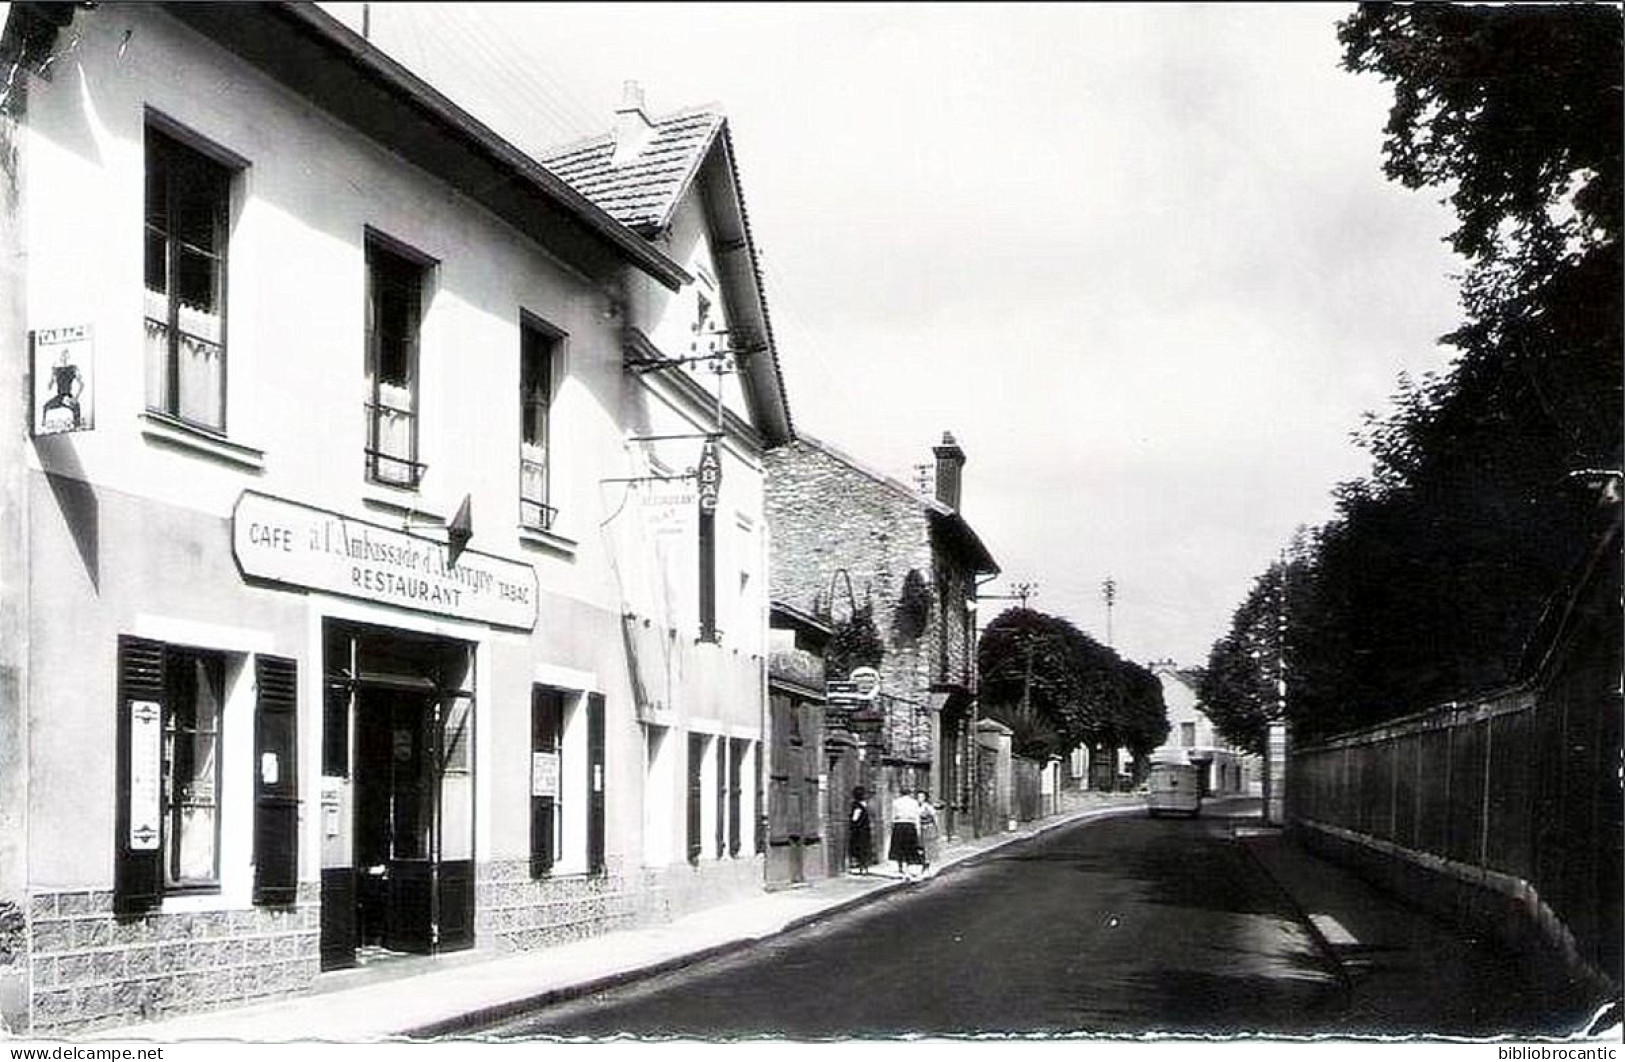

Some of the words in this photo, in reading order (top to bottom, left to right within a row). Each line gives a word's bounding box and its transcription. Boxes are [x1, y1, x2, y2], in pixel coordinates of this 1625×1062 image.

[701, 441, 720, 511] TABAC
[249, 522, 293, 553] CAFE
[351, 565, 463, 607] RESTAURANT
[498, 581, 530, 605] TABAC
